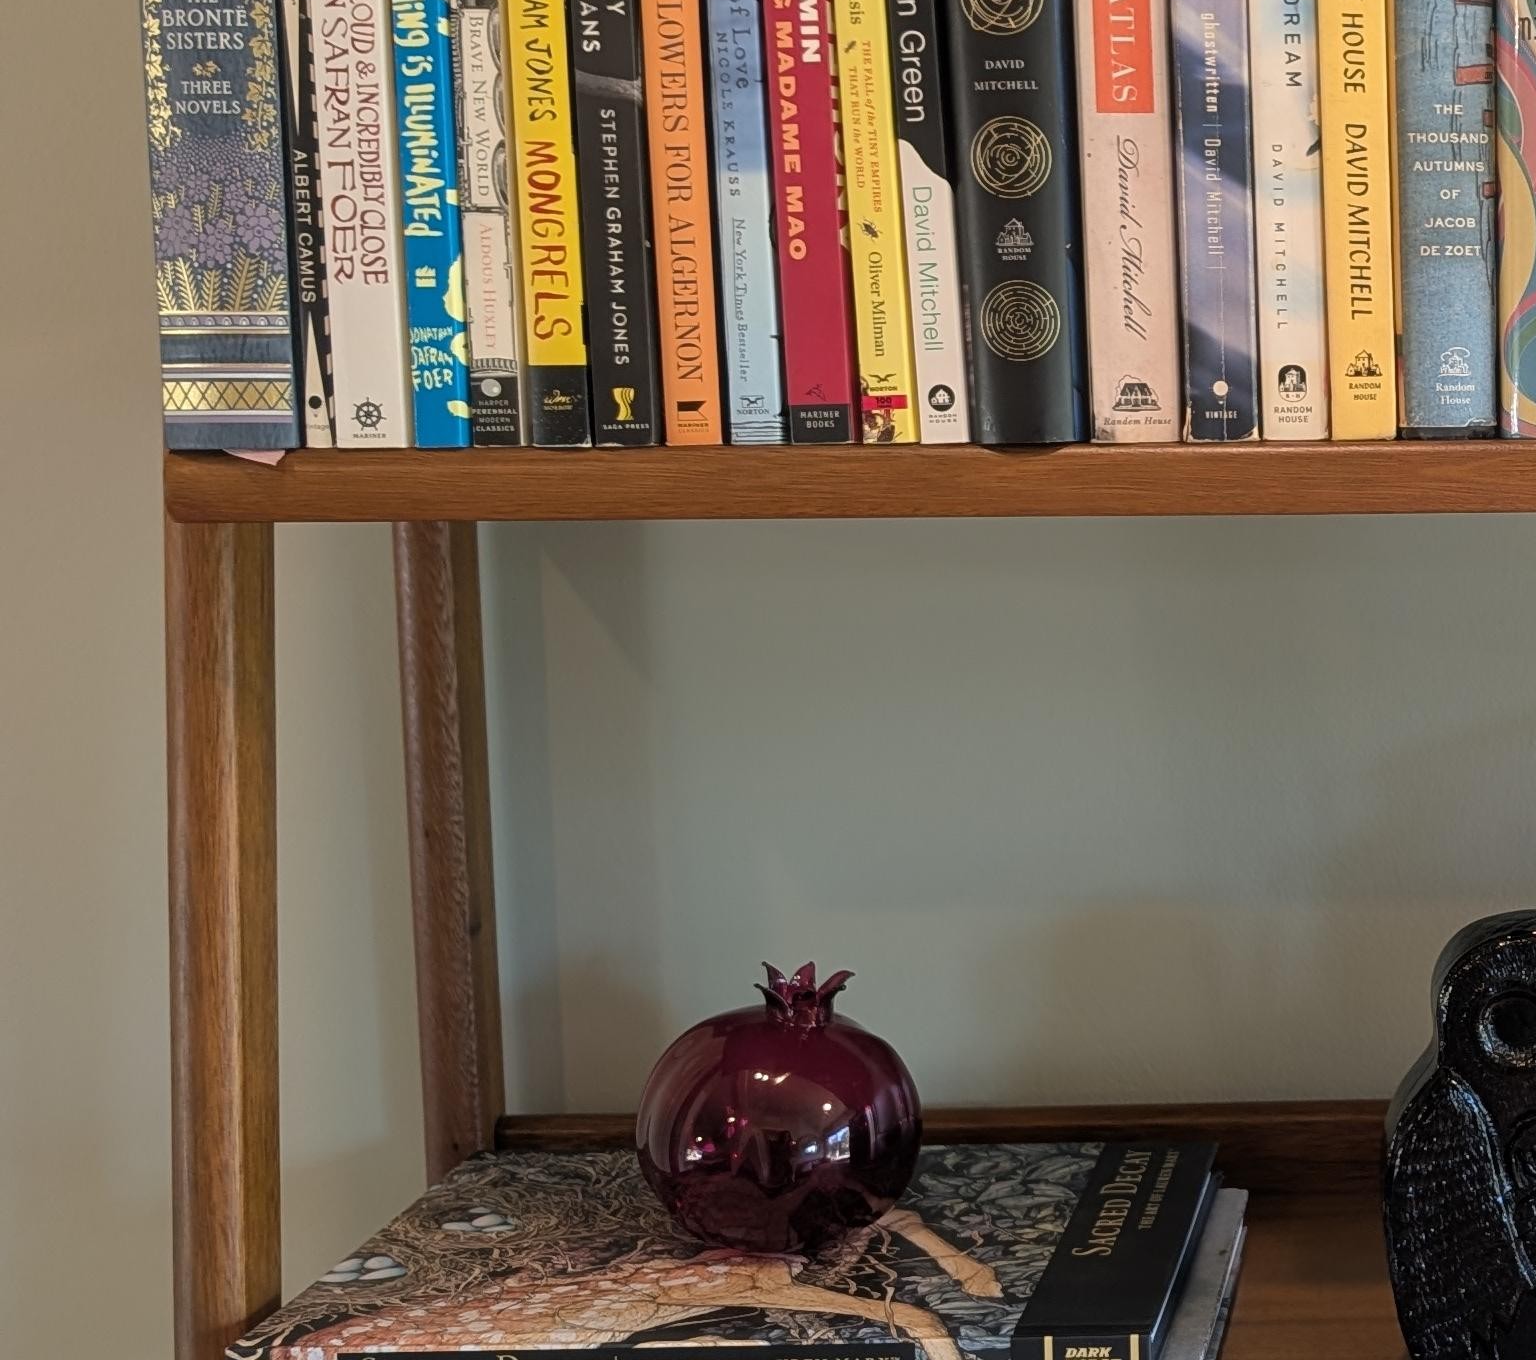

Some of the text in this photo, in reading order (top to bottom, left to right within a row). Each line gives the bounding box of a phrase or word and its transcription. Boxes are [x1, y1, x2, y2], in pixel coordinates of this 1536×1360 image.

[162, 5, 248, 27] BRONTË
[167, 31, 244, 50] SISTERS
[1200, 13, 1220, 112] ghostwritten
[182, 80, 232, 95] THREE
[525, 38, 558, 121] JONES
[776, 21, 801, 174] MADAME
[176, 100, 240, 114] NOVELS
[469, 17, 490, 197] BRAVE NEW WORLD
[1434, 105, 1463, 115] THE
[1408, 133, 1489, 144] THOUSAND
[1413, 161, 1484, 172] AUTUMNS
[1440, 190, 1460, 199] OF
[293, 149, 316, 303] ALBERT CAMUS
[784, 194, 807, 260] MAO
[1425, 218, 1476, 228] JACOB
[524, 141, 572, 340] MONGRELS
[1420, 246, 1482, 256] DE ZOET
[1064, 1346, 1112, 1359] DARK
